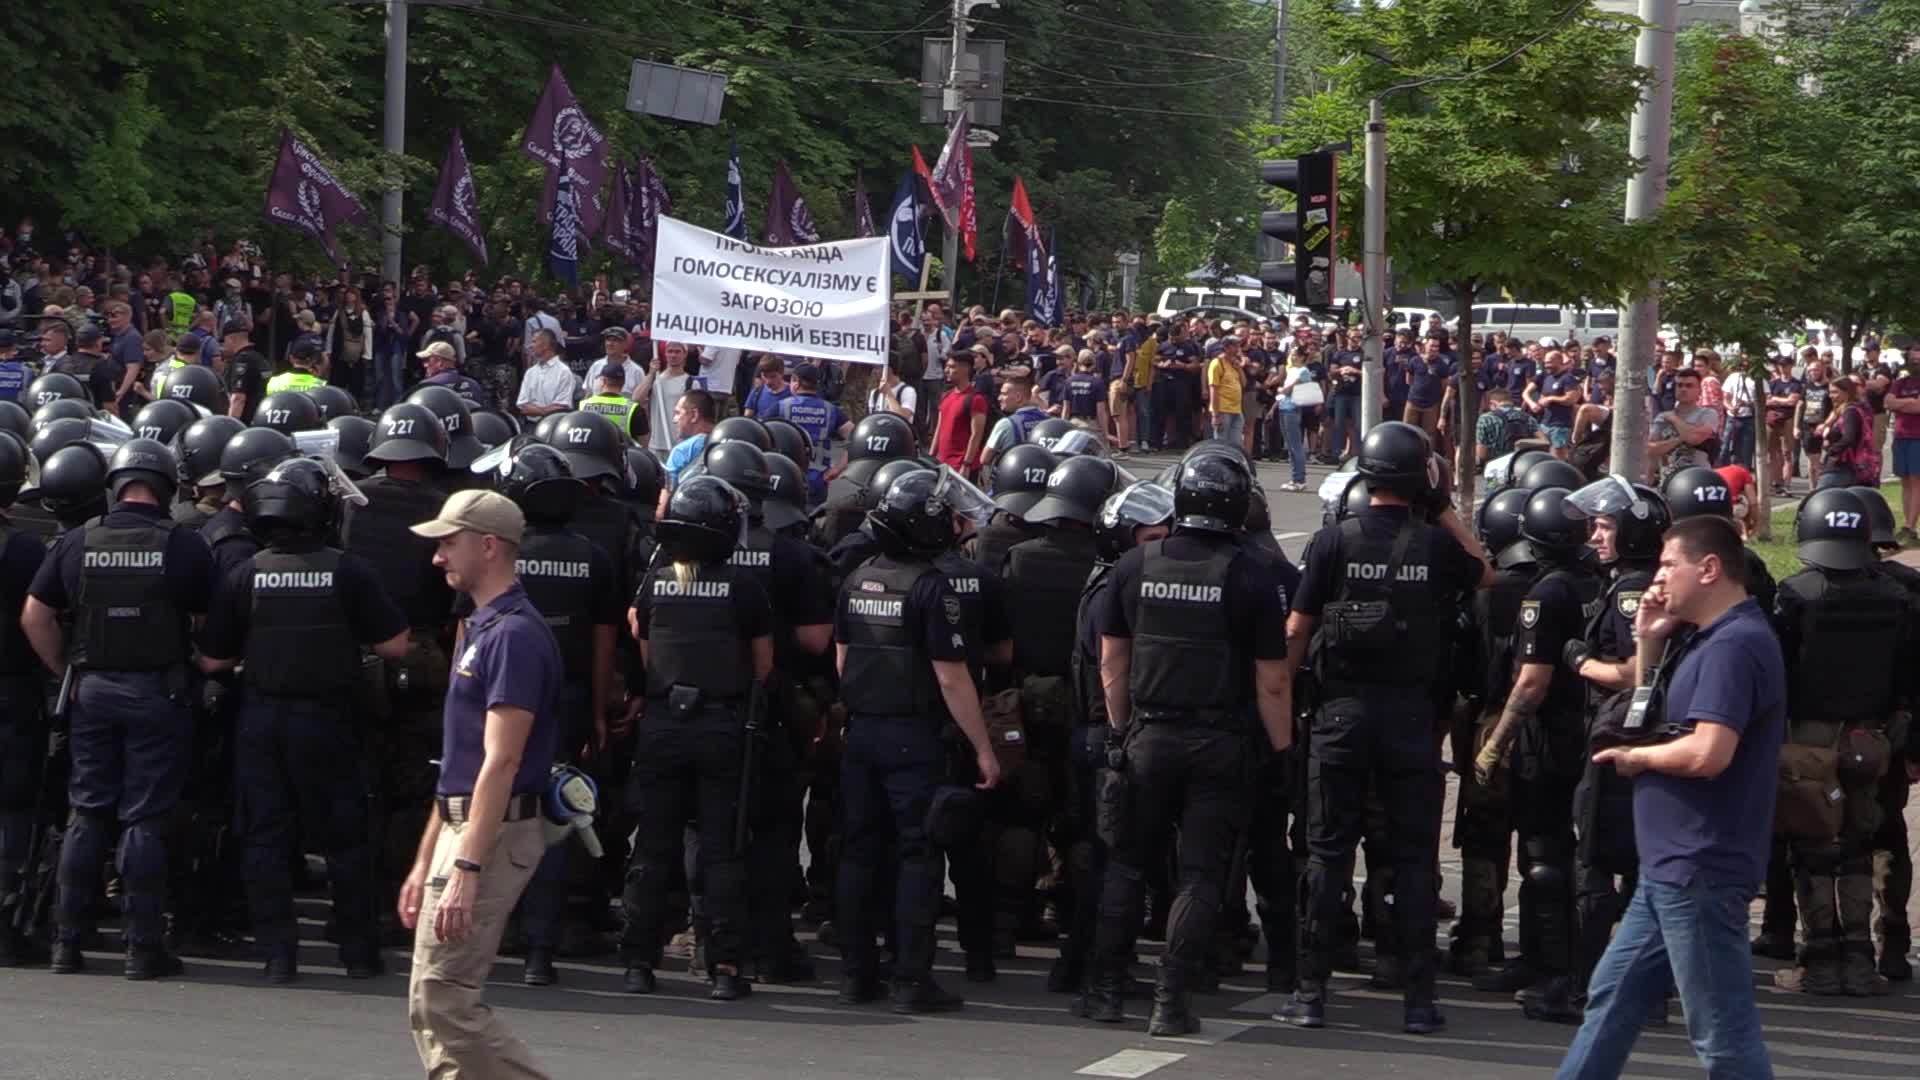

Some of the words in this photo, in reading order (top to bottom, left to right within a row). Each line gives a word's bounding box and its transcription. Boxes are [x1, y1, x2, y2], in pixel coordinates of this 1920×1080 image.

[716, 236, 844, 264] ПРОАНДА
[673, 256, 862, 291] ГОМОСЕКСУАЛІЗМУ
[866, 276, 878, 293] Є
[720, 291, 824, 318] ЗАГРОЗОЮ
[655, 312, 804, 344] НАЦІОНАЛЬНІЙ
[809, 329, 886, 356] БЕЗПЕЦІ
[171, 384, 194, 398] 527
[265, 409, 291, 424] 127
[138, 426, 162, 440] 127
[387, 419, 415, 436] 227
[567, 427, 592, 444] 127
[866, 436, 890, 452] 127
[1023, 467, 1047, 483] 127
[1693, 486, 1728, 502] 127
[1825, 511, 1862, 529] 127
[84, 552, 163, 568] ПОЛІЦІЯ
[727, 550, 771, 566] ІЦІЯ
[514, 559, 590, 578] ПОЛІЦІЯ
[1346, 562, 1429, 581] ПОЛЦІЯ
[254, 571, 334, 588] ПОЛІЦІЯ
[653, 580, 731, 598] ПОЛІЦІЯ
[1140, 581, 1223, 602] ПОЛІЦІЯ
[848, 597, 903, 617] ПОЛІЦІЯ
